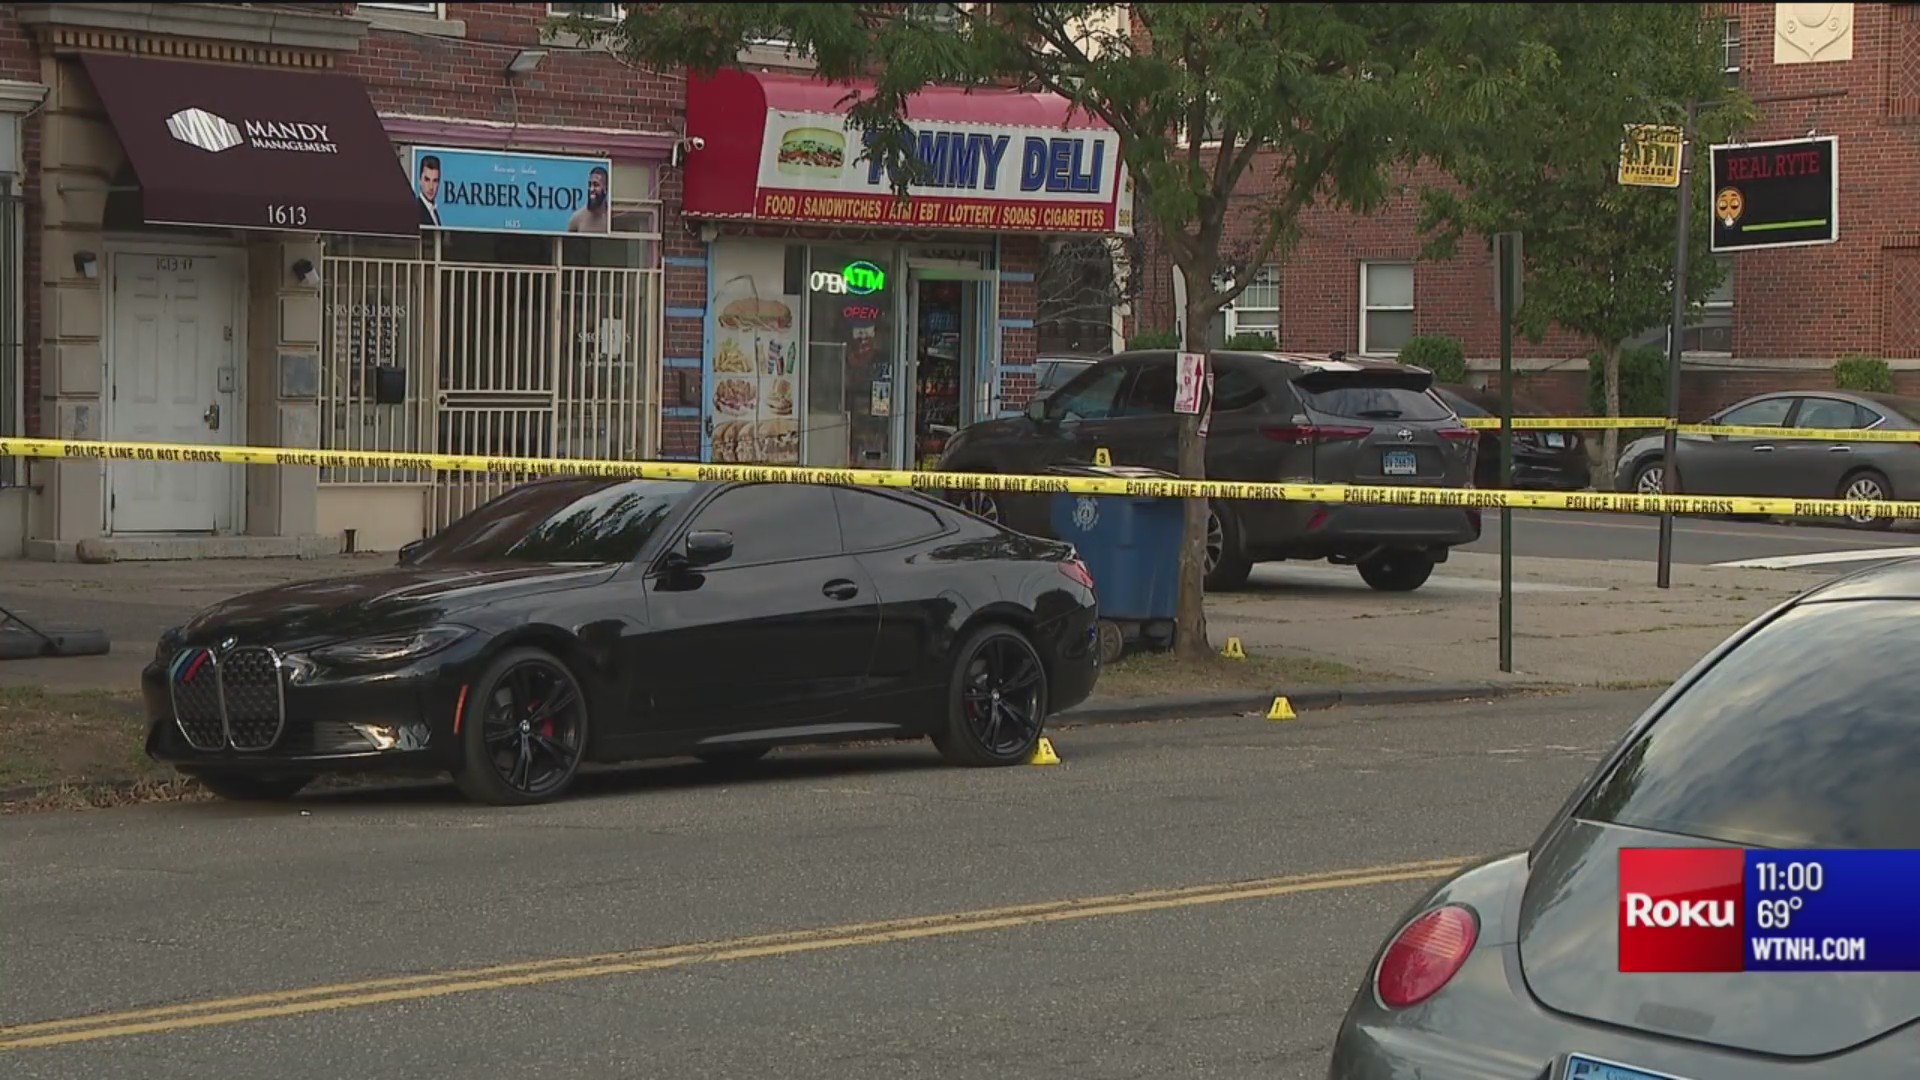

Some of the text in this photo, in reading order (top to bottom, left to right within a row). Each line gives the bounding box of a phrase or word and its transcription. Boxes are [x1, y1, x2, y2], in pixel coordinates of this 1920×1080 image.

[245, 119, 330, 143] MANDY
[252, 138, 339, 154] MANAGEMENT
[1020, 136, 1104, 193] DELI
[1626, 166, 1674, 176] INSIDE
[1728, 151, 1820, 181] REAL RYTE
[444, 180, 584, 211] BARBER SHOP
[268, 204, 306, 225] 1613
[765, 195, 796, 215] FOOD
[804, 197, 882, 218] SANDWITCHES
[889, 201, 912, 220] ATM
[920, 202, 940, 221] EBT
[950, 204, 996, 223] LOTTERY
[1002, 206, 1036, 225] SODAS
[1043, 208, 1104, 226] CIGARETTES
[810, 271, 846, 294] OPEN
[844, 266, 884, 290] ATM
[843, 306, 878, 319] OPEN
[64, 445, 221, 462] POLICE LINE DO NOT CROSS
[276, 454, 431, 469] POLICE LINE DO NOT CROSS
[1100, 452, 1106, 464] 3
[488, 461, 642, 478] POLICE LINE DO NOT CROSS
[698, 467, 854, 485] POLICE LINE DO NOT CROSS
[912, 474, 1068, 492] POLICE LINE DO NOT CROSS
[1126, 480, 1285, 499] POLICE LINE DO NOT CROSS
[1344, 489, 1506, 507] POLICE LINE DO NOT CROSS
[1566, 496, 1733, 513] POLICE LINE DO NOT CROSS
[1794, 503, 1920, 519] POLICE LINE DO NOT
[1044, 744, 1051, 754] 2
